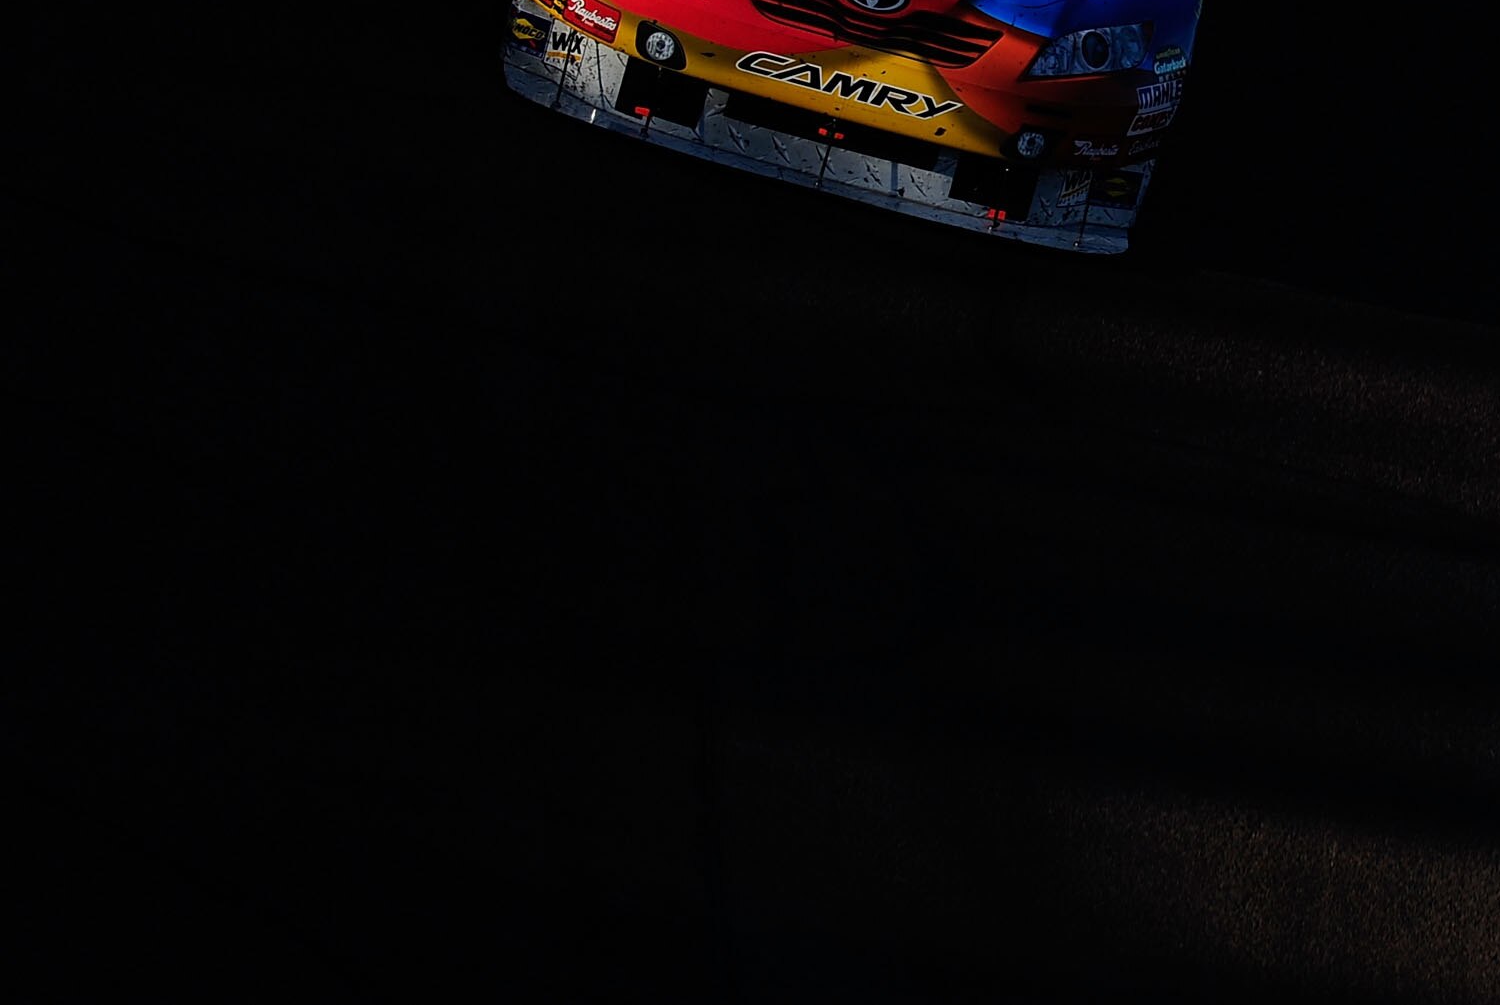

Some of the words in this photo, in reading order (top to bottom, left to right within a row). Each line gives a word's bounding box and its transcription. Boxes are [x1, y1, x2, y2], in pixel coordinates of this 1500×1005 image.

[507, 19, 546, 41] NOCO
[552, 27, 585, 55] WIX
[735, 51, 965, 120] CAMRY
